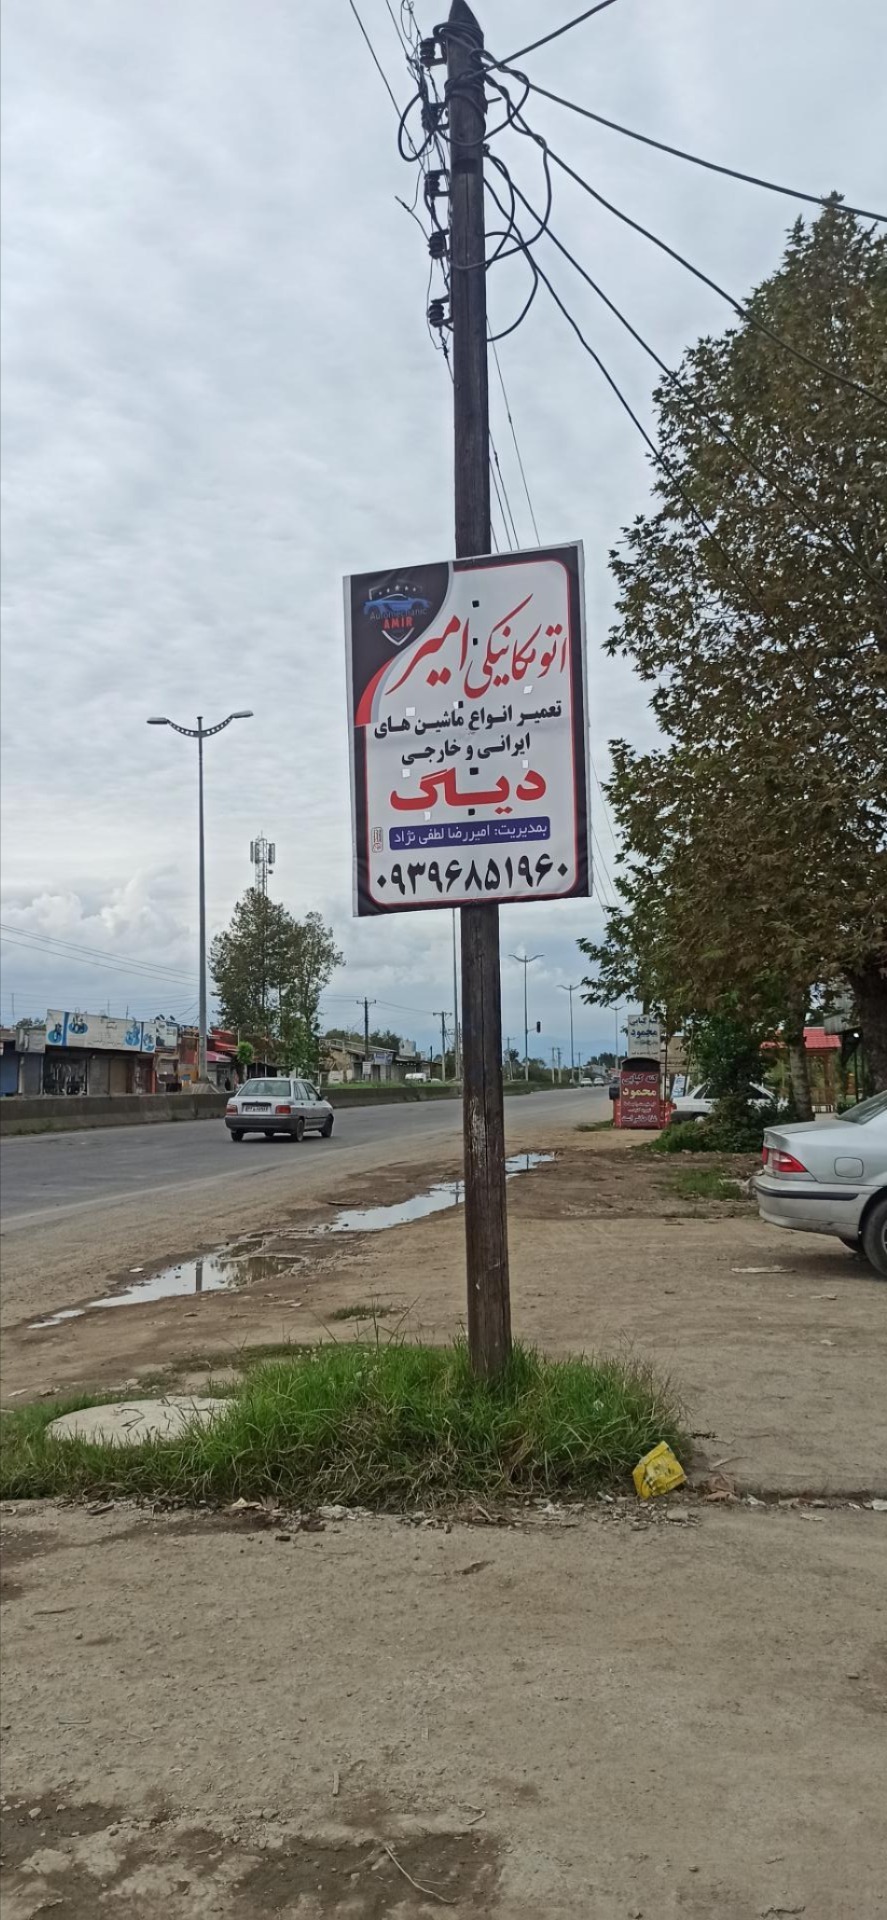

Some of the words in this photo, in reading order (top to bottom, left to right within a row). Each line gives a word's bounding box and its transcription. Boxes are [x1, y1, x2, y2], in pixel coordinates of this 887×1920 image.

[383, 616, 413, 629] AMIR
[385, 614, 470, 696] امیر
[415, 709, 464, 735] ماشین
[468, 704, 513, 731] انواع
[516, 700, 562, 727] تعمیر
[374, 715, 411, 739] های
[401, 738, 461, 766] خارجی
[465, 744, 474, 761] و
[477, 731, 531, 759] ایرانی
[389, 767, 547, 815] دیاگ
[394, 830, 416, 846] نژاد
[418, 827, 445, 845] لطفی
[494, 824, 548, 839] بمدیریت:
[376, 853, 568, 896] ۰۹۳۹۶۸۵۱۹۶۰
[630, 1029, 658, 1039] محمود
[622, 1086, 657, 1099] محمود
